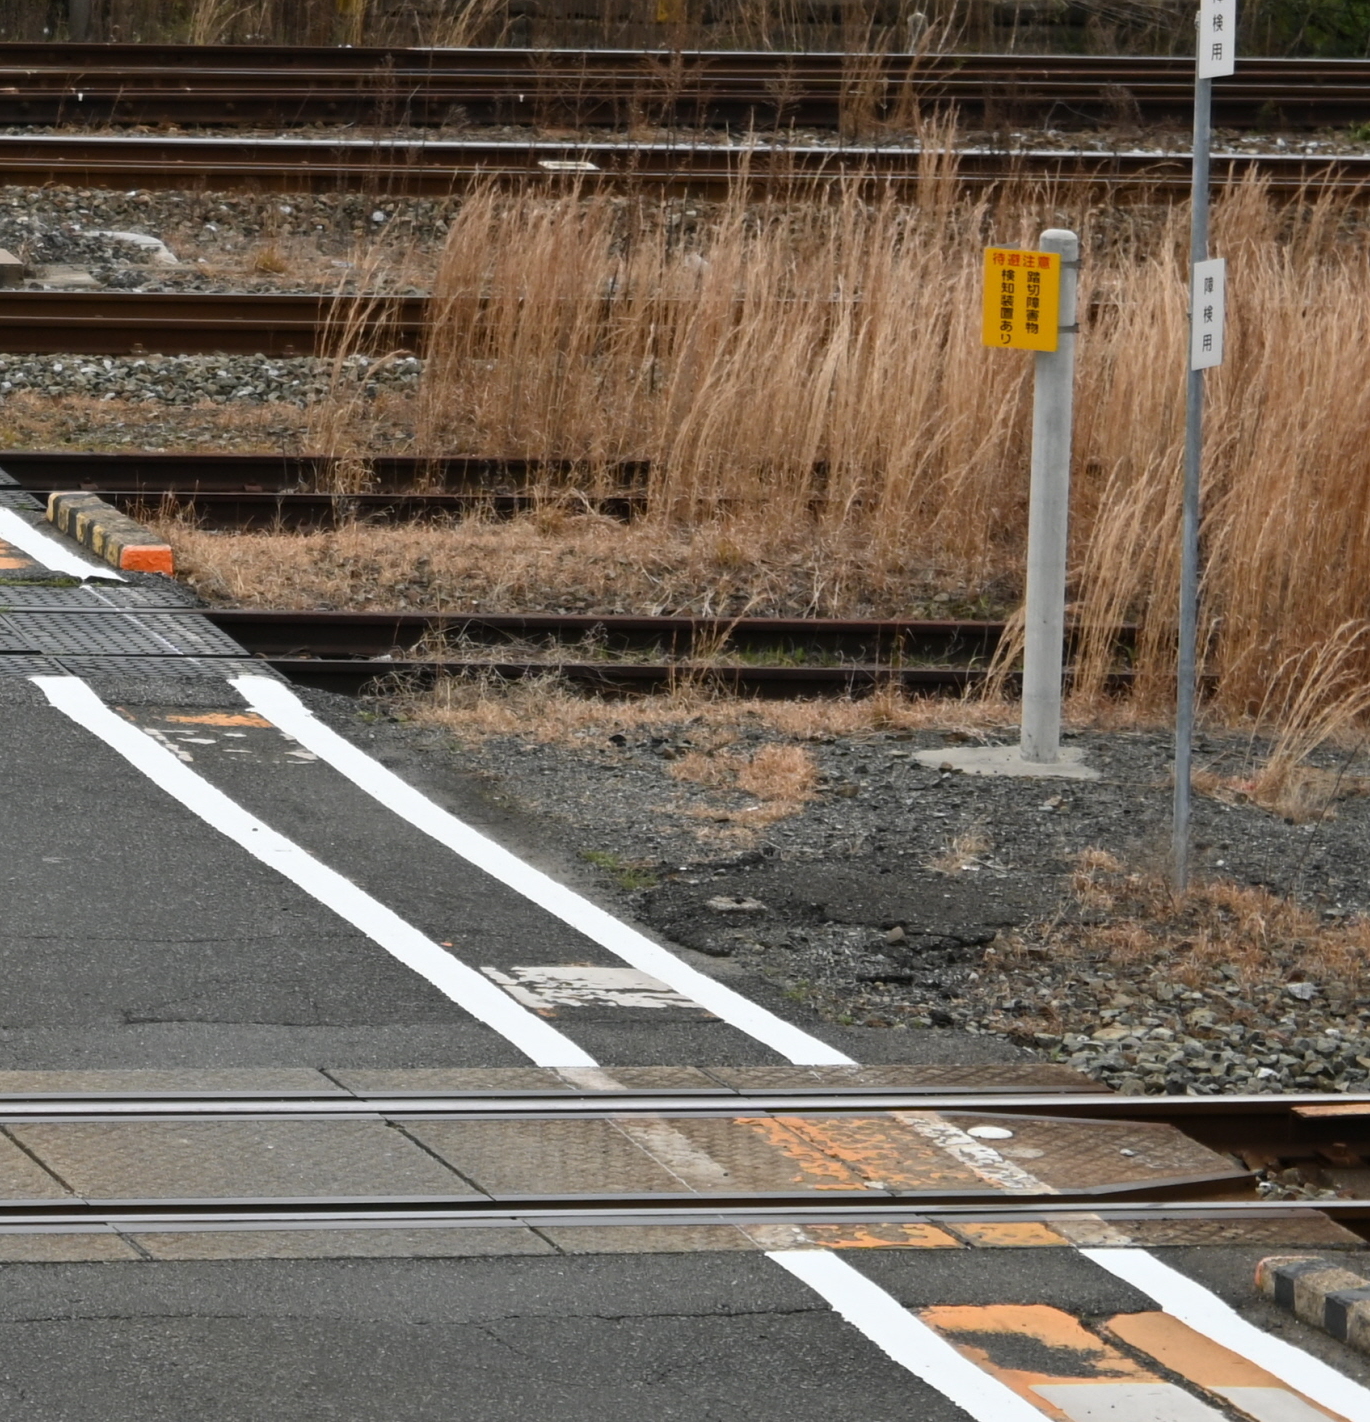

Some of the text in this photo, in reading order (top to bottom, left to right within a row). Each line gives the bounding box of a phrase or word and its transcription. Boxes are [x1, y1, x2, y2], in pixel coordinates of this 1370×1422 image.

[992, 252, 1051, 270] 待避注意
[1000, 269, 1015, 345] 検知装置あり
[1025, 271, 1040, 335] 踏切障害物
[1202, 276, 1214, 353] 障検用
